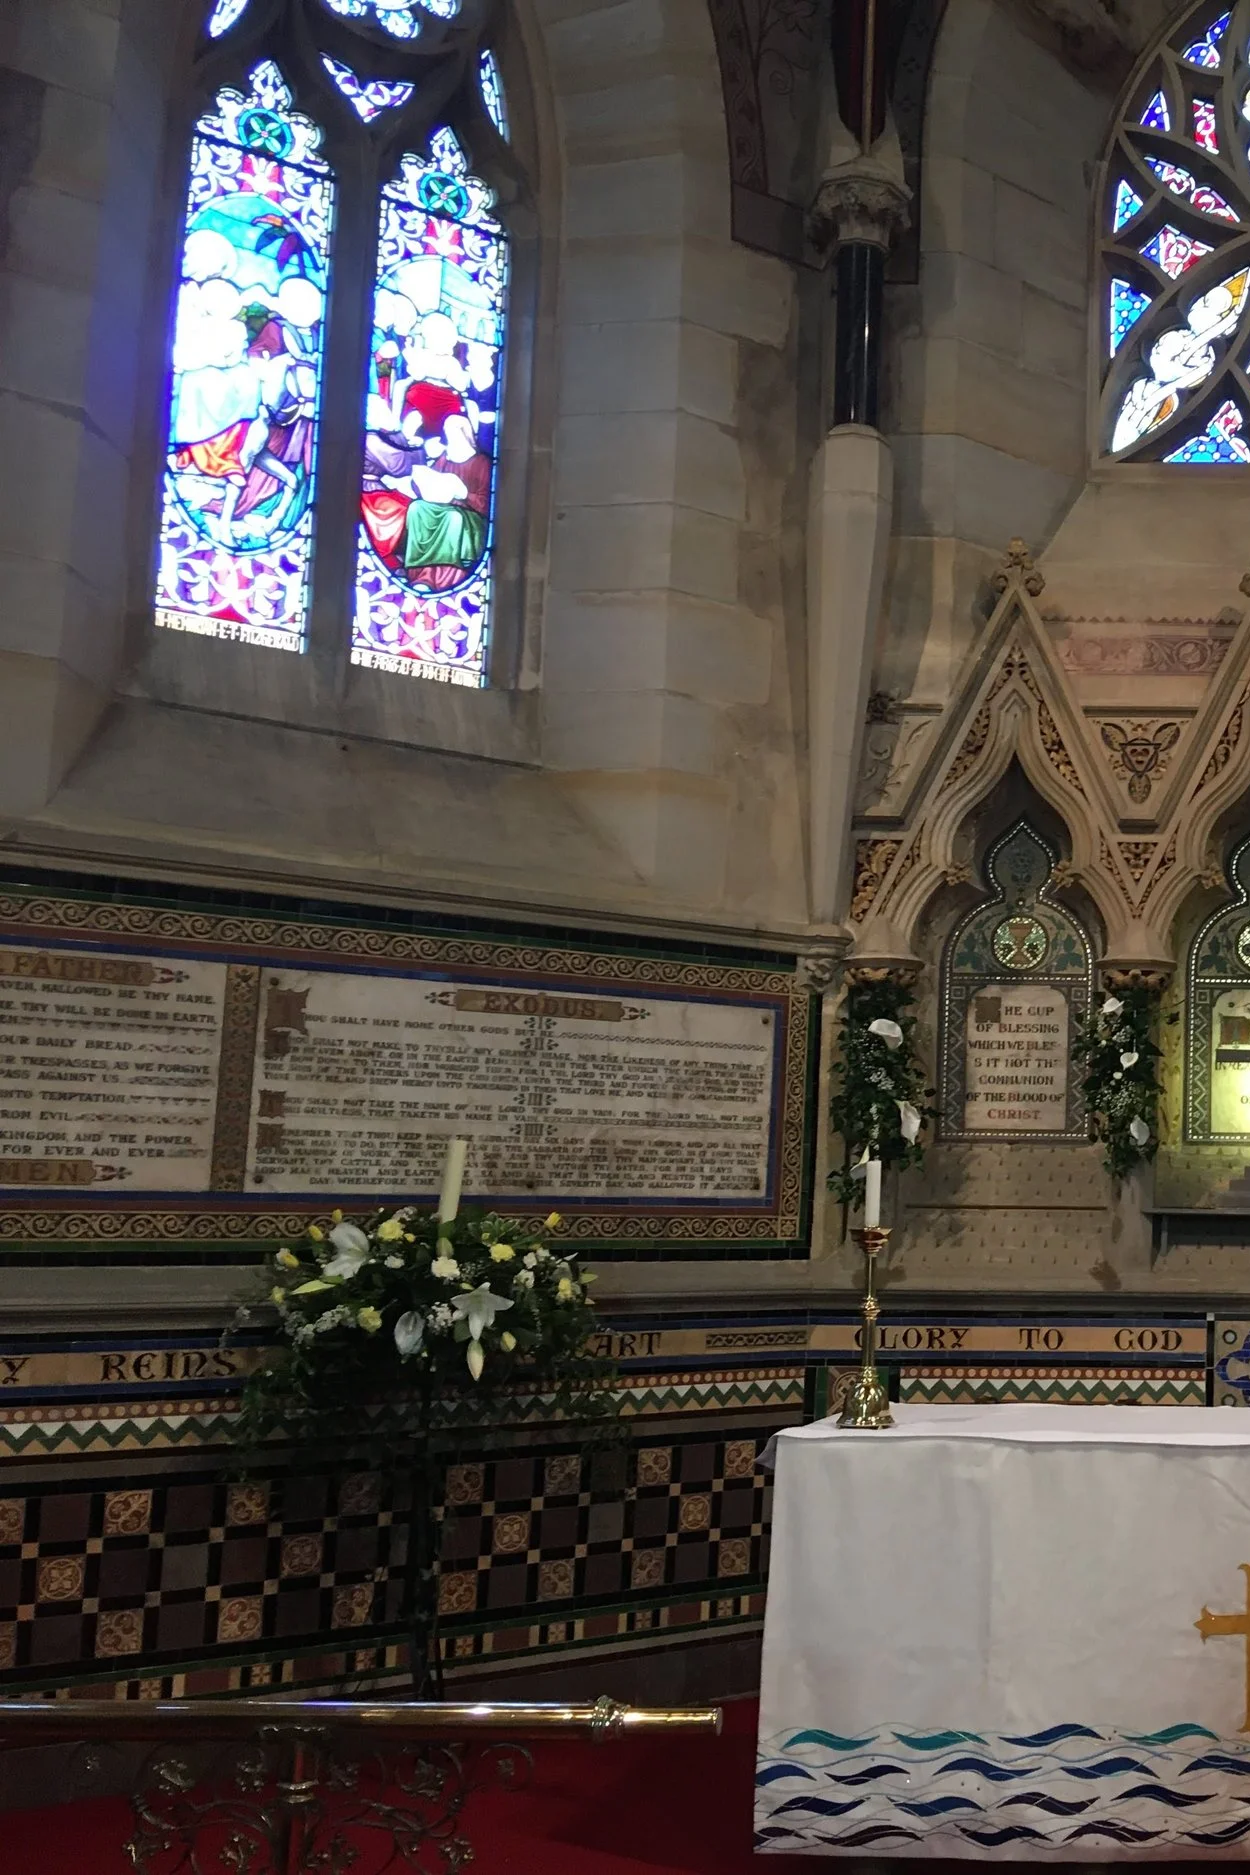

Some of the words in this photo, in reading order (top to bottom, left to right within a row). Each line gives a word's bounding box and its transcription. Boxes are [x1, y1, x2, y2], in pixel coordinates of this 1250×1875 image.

[41, 983, 112, 997] HALLOWED
[118, 989, 137, 999] BE
[143, 991, 170, 1001] THY
[21, 1002, 50, 1013] THY
[54, 1004, 88, 1015] WILL
[93, 1007, 111, 1017] BE
[1027, 1006, 1055, 1017] CUP
[975, 1023, 993, 1034] OF
[998, 1023, 1060, 1034] BLESSING
[36, 1036, 77, 1048] DAILY
[967, 1040, 1006, 1051] WHICH
[1007, 1040, 1024, 1051] WE
[114, 1060, 130, 1071] AS
[134, 1062, 155, 1073] WE
[986, 1058, 1000, 1069] IT
[1005, 1058, 1033, 1069] NOT
[37, 1071, 96, 1083] AGAINST
[978, 1075, 1055, 1086] COMMUNION
[965, 1092, 982, 1103] OF
[983, 1092, 1007, 1103] THE
[1007, 1093, 1048, 1103] BLOOD
[1049, 1093, 1066, 1104] OF
[75, 1133, 103, 1143] AND
[109, 1133, 138, 1144] THE
[2, 1144, 32, 1155] FOR
[44, 1146, 85, 1157] EVER
[91, 1147, 122, 1158] AND
[128, 1148, 165, 1159] EVER
[583, 1331, 663, 1358] ART
[1018, 1327, 1064, 1351] TO
[1113, 1328, 1184, 1352] GOD
[100, 1350, 238, 1382] REINS
